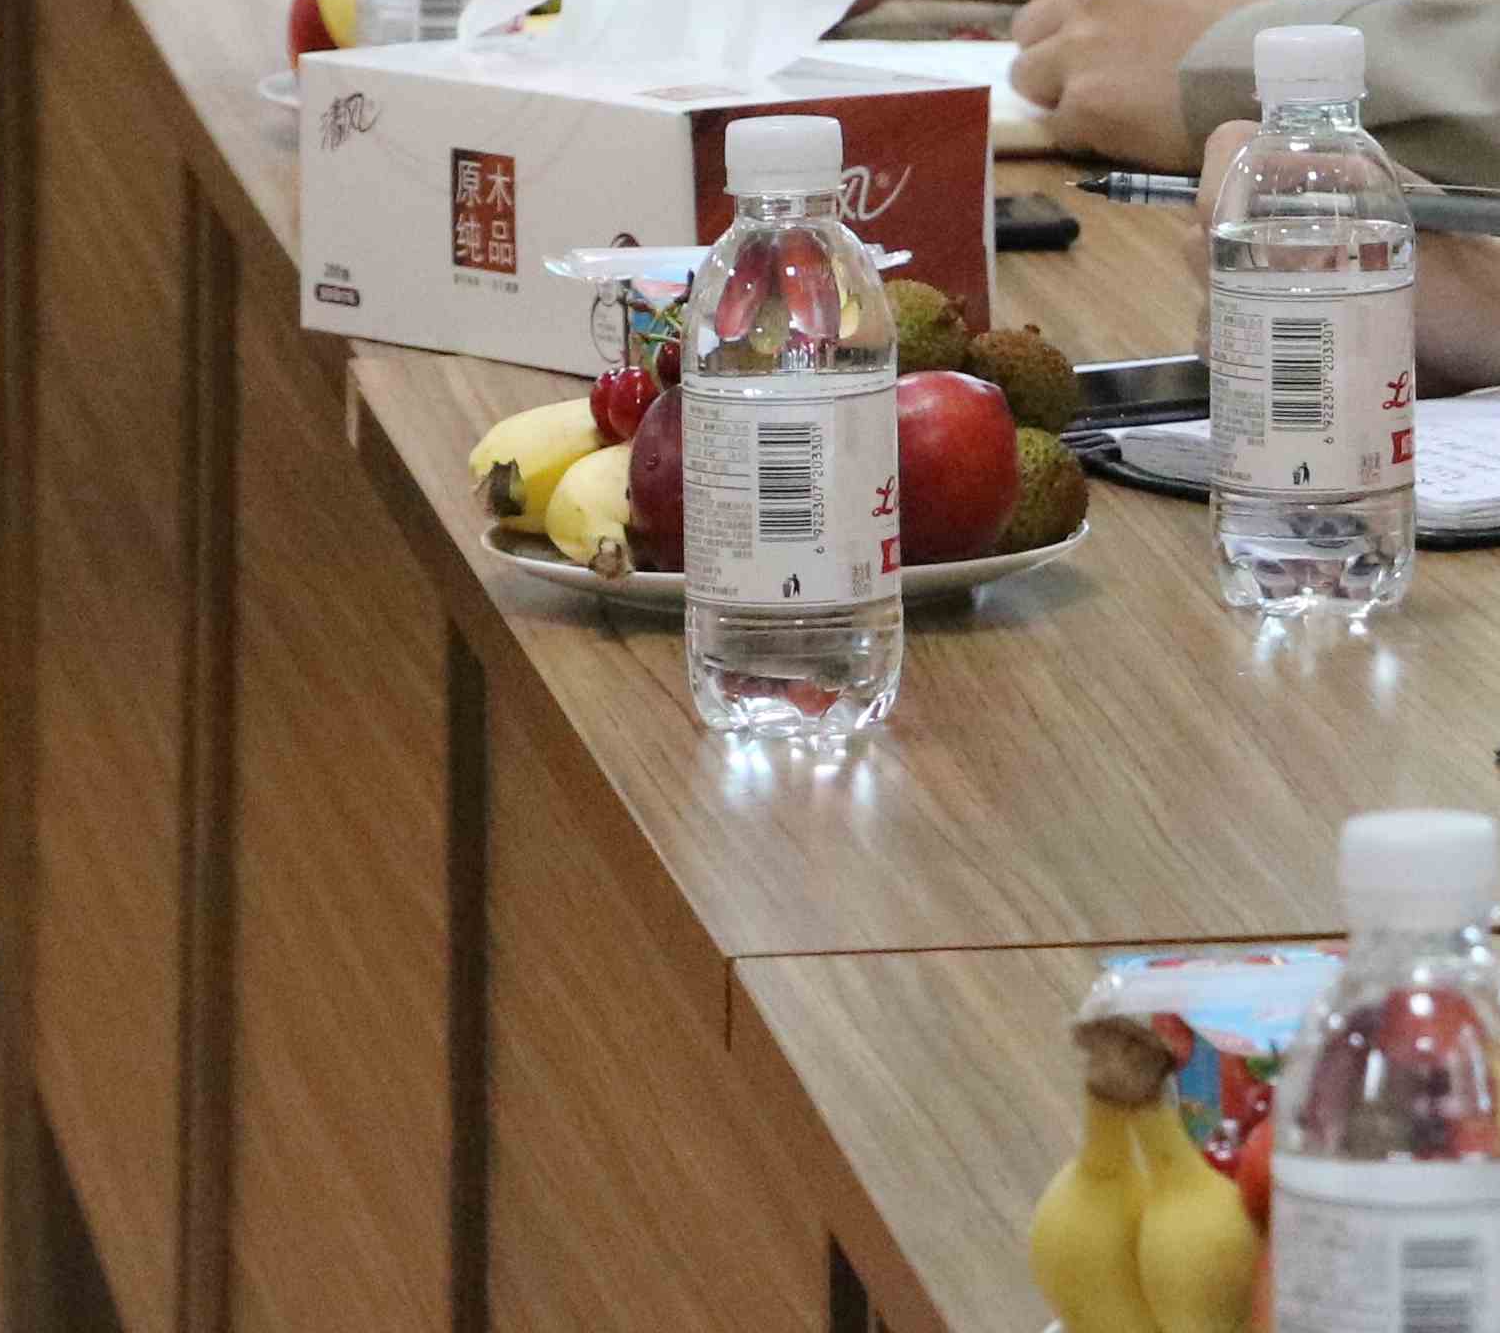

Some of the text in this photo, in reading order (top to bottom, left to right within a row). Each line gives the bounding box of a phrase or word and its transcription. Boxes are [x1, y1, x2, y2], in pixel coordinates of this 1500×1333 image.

[455, 160, 515, 213] 原木
[455, 213, 516, 267] 纯品
[1323, 322, 1335, 372] 203301
[1323, 379, 1335, 430] 922307
[811, 425, 825, 478] 203301
[812, 485, 825, 537] 922307
